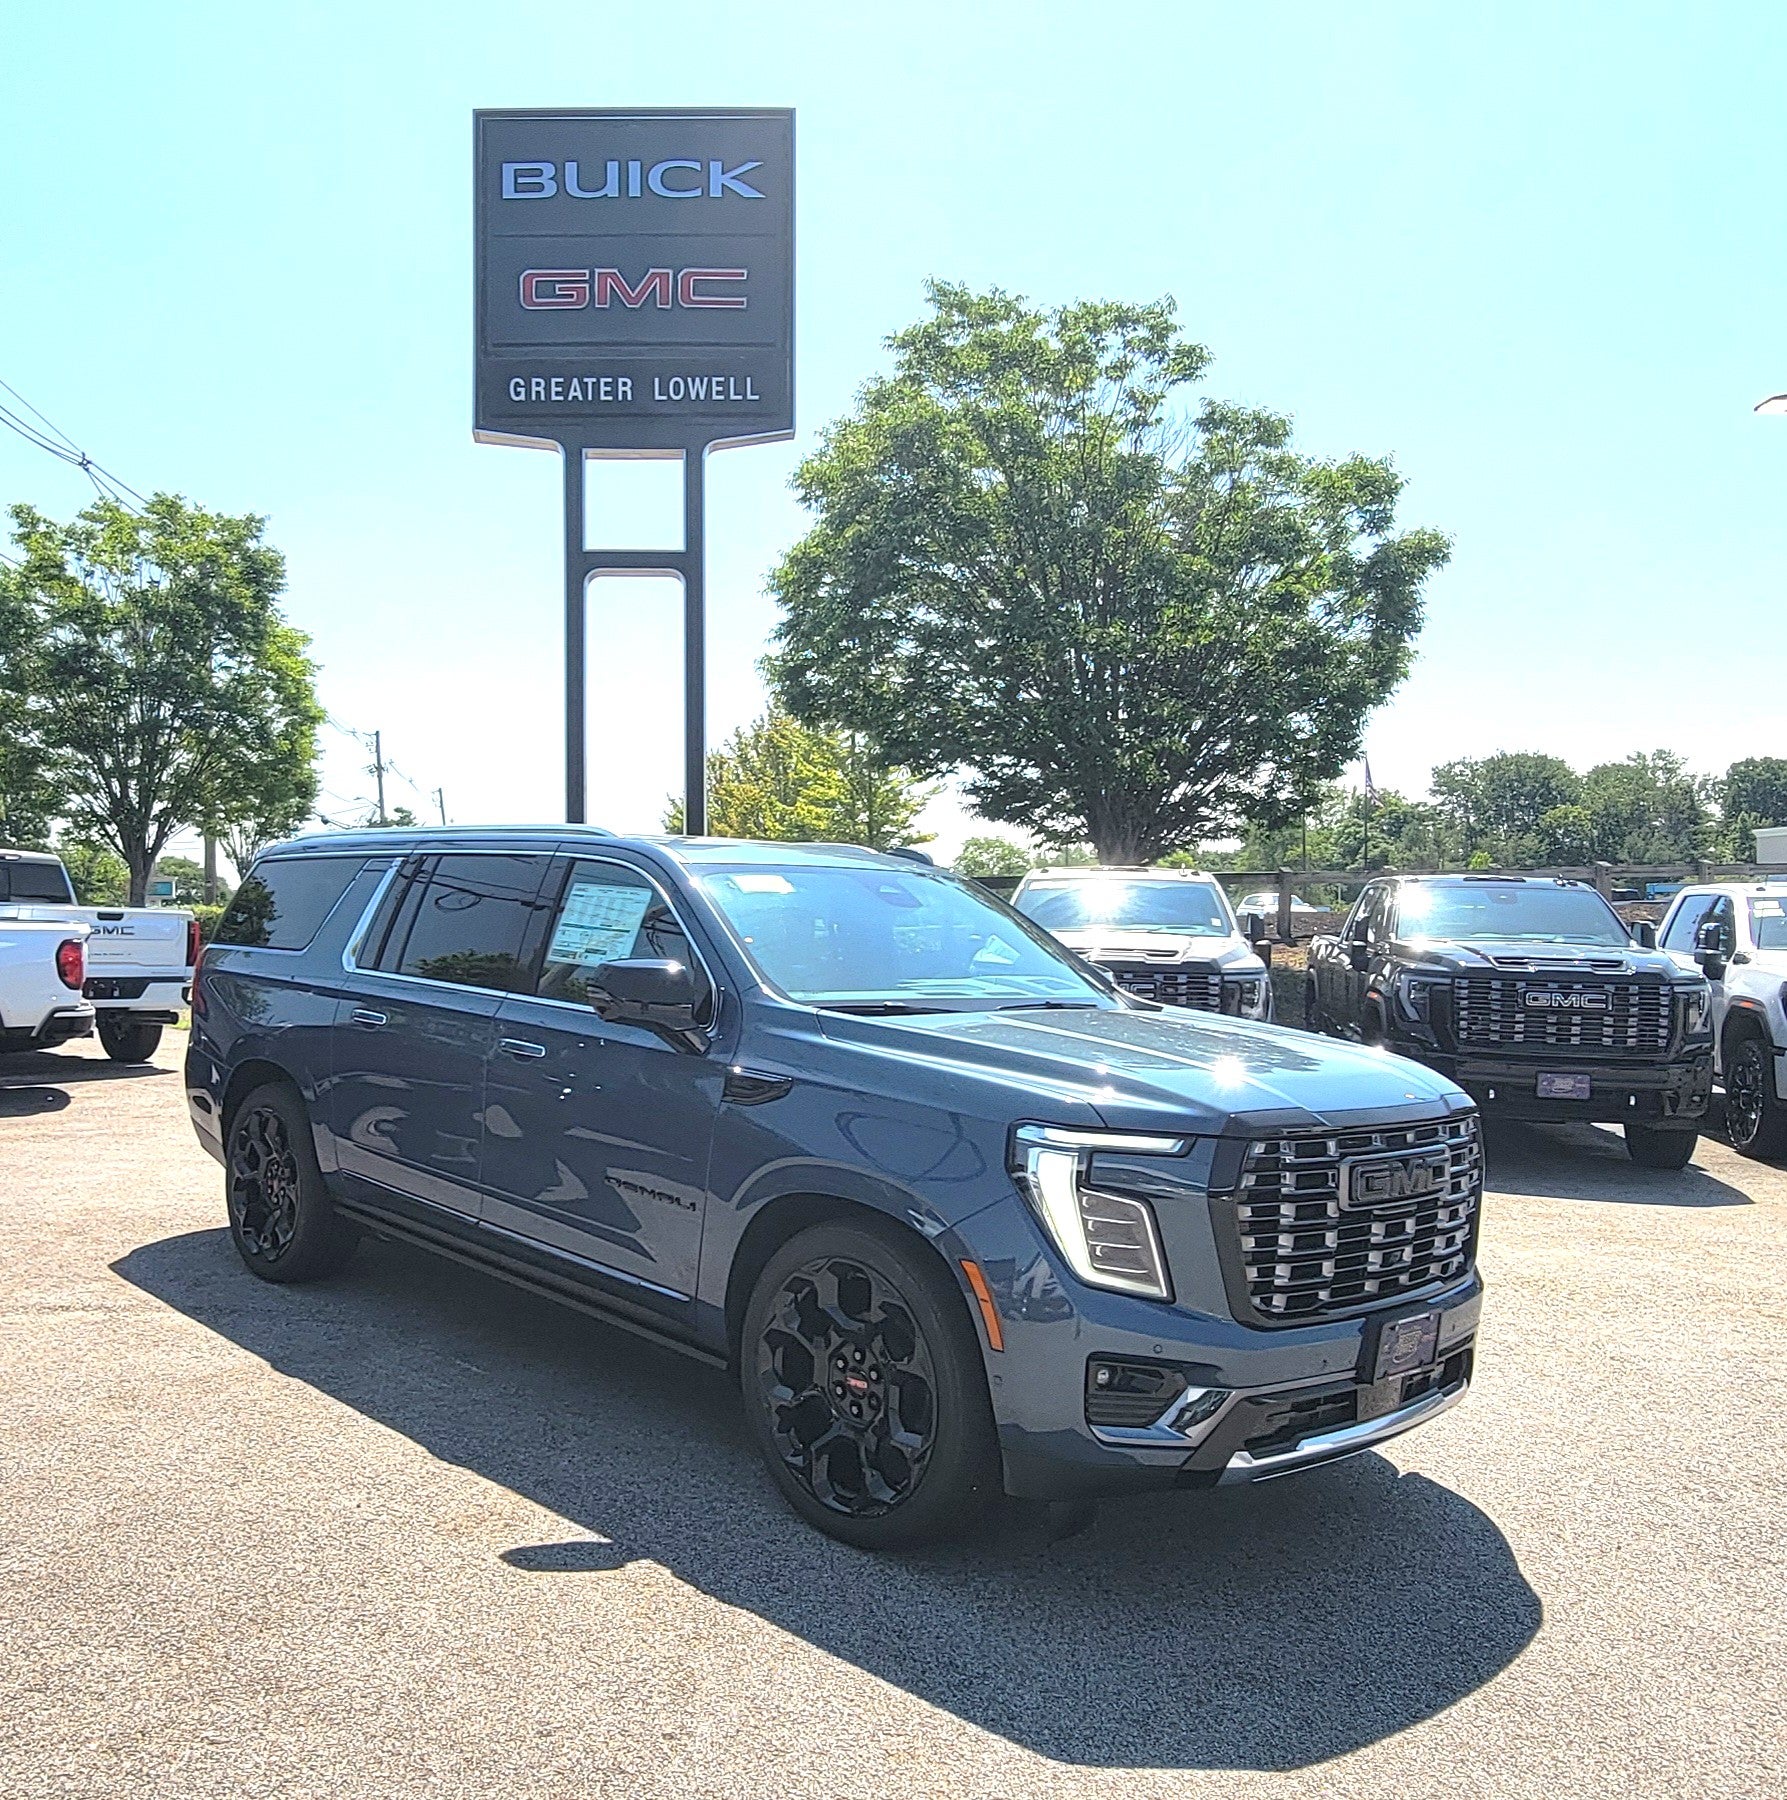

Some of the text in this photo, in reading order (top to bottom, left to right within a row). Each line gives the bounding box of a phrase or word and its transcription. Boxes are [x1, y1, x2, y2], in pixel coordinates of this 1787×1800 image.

[501, 159, 766, 200] BUICK
[519, 267, 748, 311] GMC
[508, 376, 760, 403] GREATER LOWELL
[90, 925, 135, 936] GMC
[1525, 992, 1607, 1009] GMC
[1353, 1154, 1450, 1201] GMC
